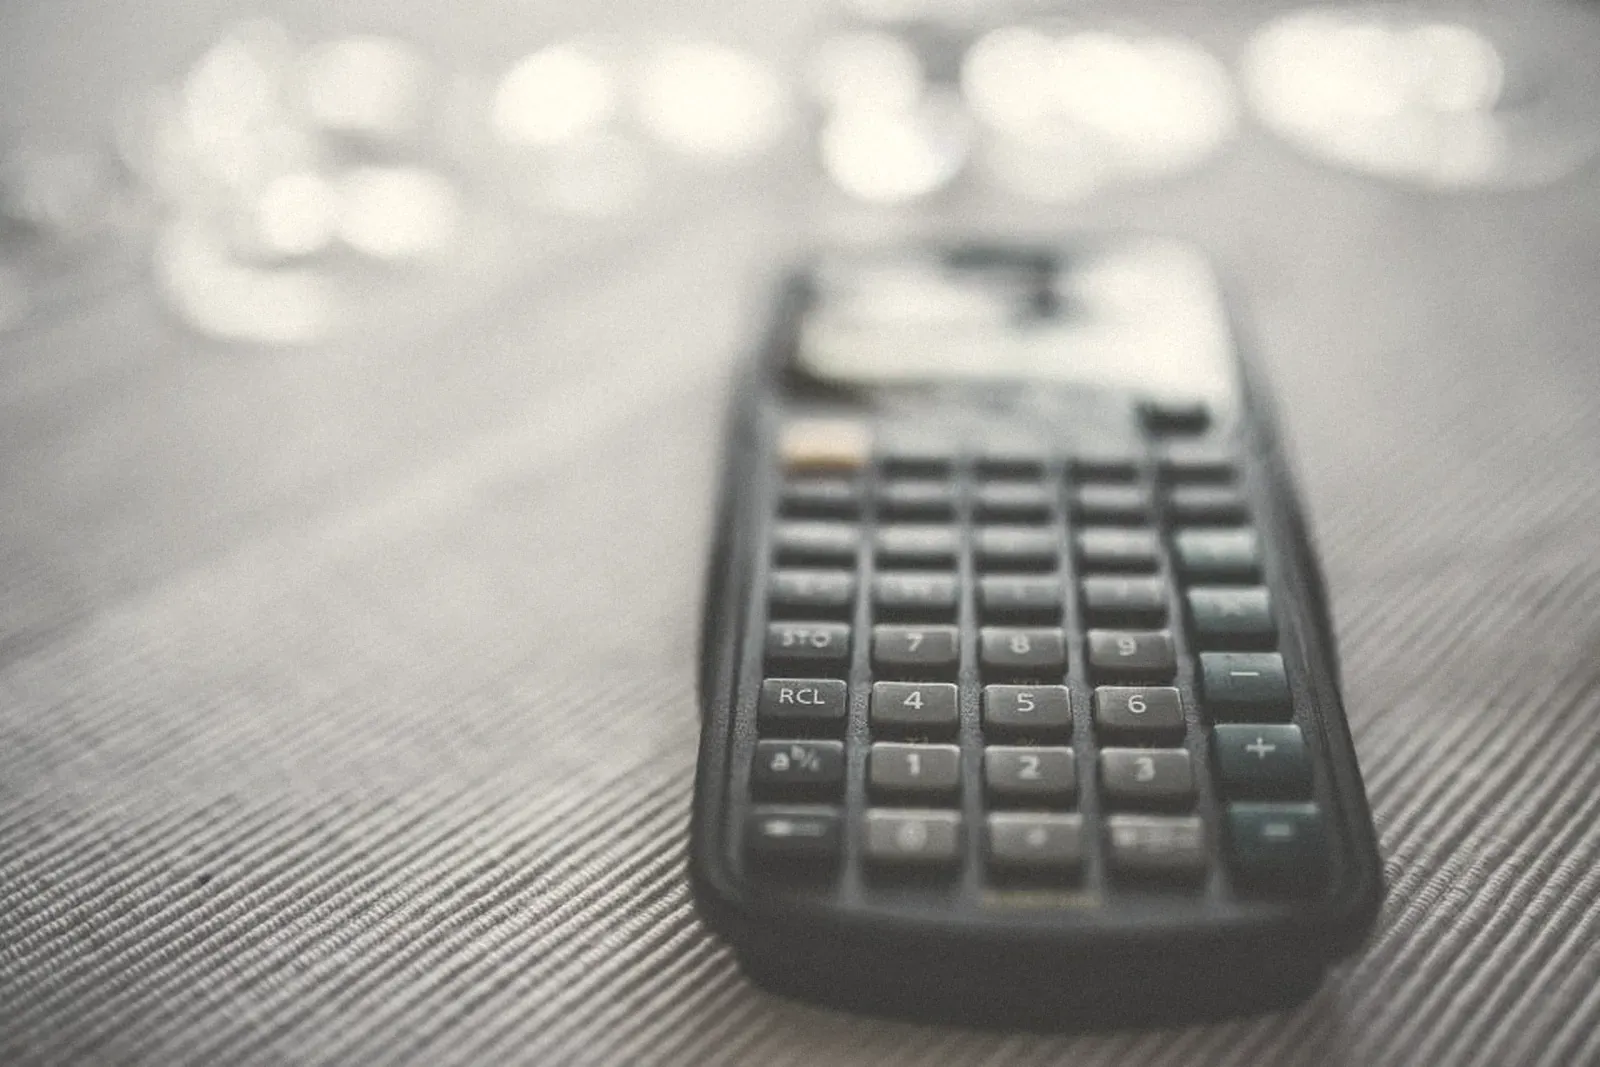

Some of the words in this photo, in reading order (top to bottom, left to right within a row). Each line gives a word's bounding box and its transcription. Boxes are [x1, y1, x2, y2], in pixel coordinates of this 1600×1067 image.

[904, 633, 923, 651] 7
[1010, 635, 1030, 654] 8
[1117, 638, 1137, 656] 9
[779, 688, 825, 705] RCL
[903, 691, 924, 710] 4
[1016, 693, 1035, 712] 5
[1128, 695, 1147, 713] 6
[906, 753, 921, 776] 1
[1018, 756, 1041, 780] 2
[1133, 757, 1155, 782] 3
